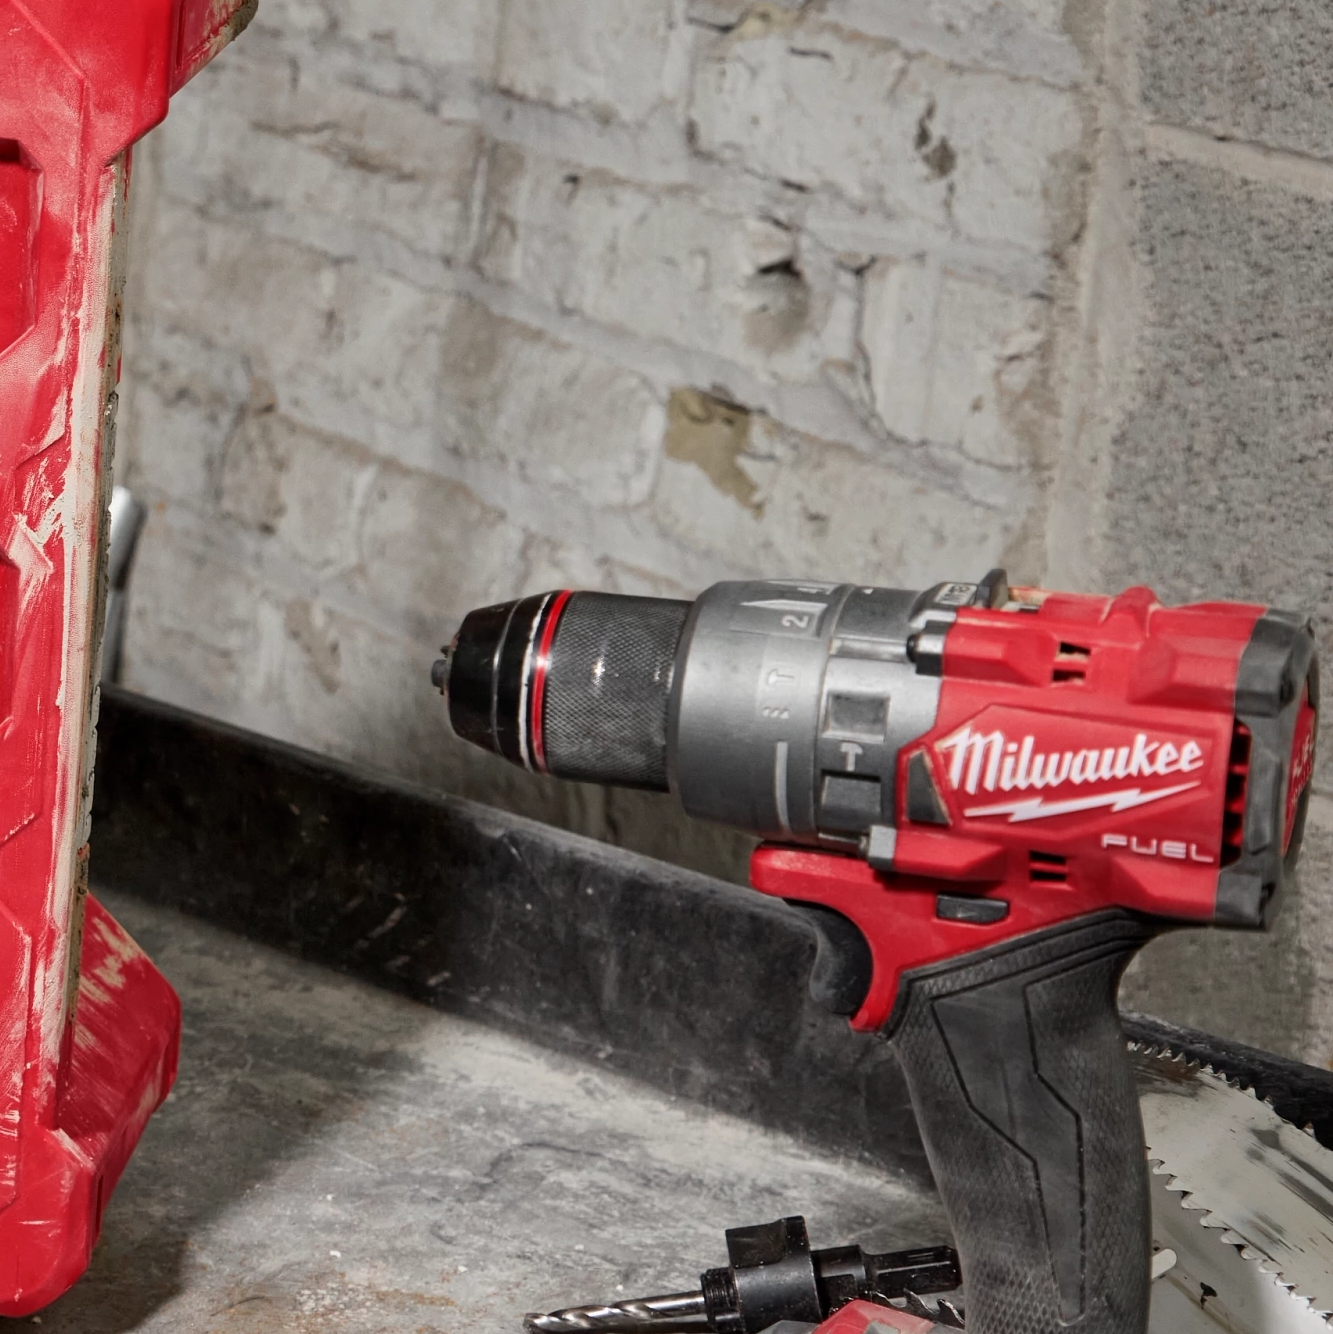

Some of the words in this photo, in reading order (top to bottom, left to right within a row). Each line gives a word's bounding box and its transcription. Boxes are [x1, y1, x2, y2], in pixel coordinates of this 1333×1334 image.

[782, 614, 809, 628] 2
[937, 726, 1205, 796] Milwaukee
[1101, 833, 1215, 863] FUEL
